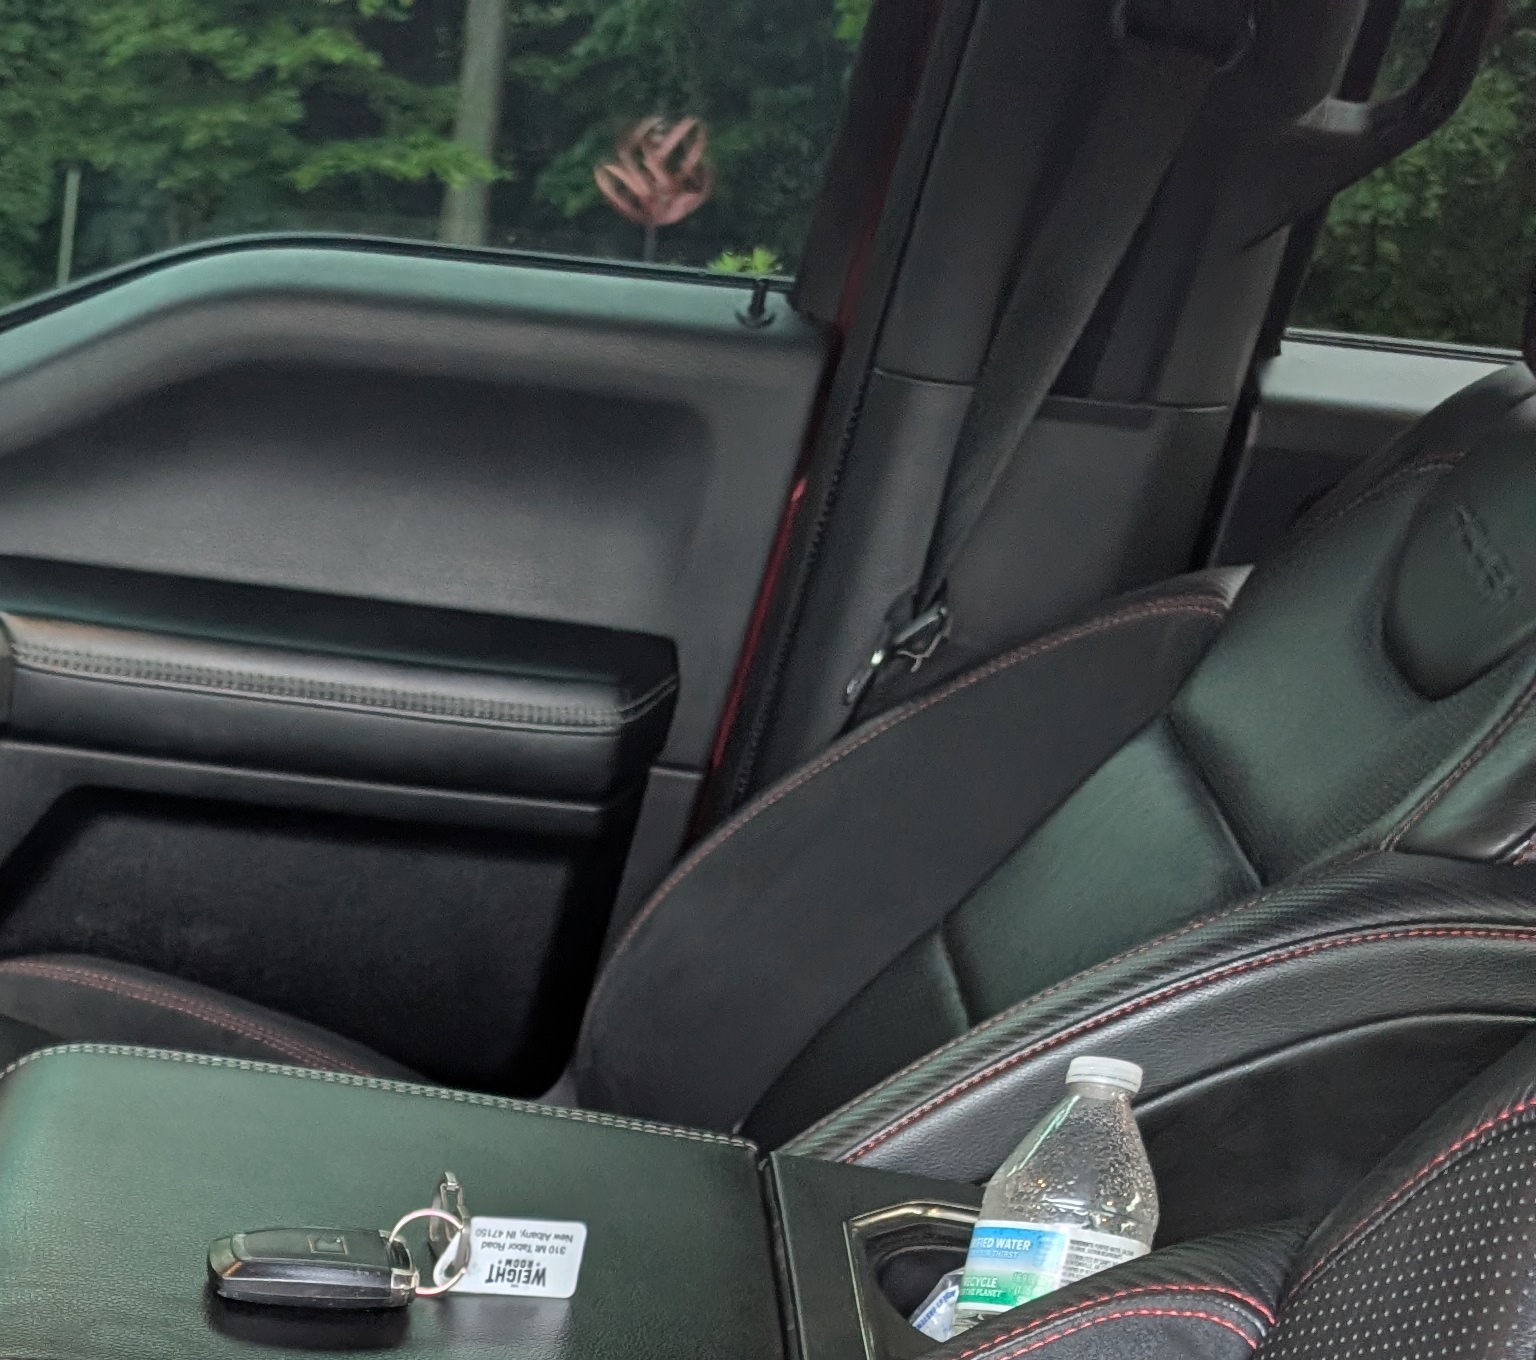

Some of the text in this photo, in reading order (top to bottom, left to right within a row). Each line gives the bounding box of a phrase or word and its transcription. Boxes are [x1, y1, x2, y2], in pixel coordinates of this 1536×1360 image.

[476, 1229, 573, 1243] New Albany, IN 47150
[481, 1241, 566, 1255] 310 Mt Tabor Road
[995, 1238, 1032, 1251] WATER
[992, 1250, 1019, 1260] THIRST
[505, 1259, 534, 1268] ROOM
[485, 1263, 547, 1287] WEIGHT
[975, 1289, 1003, 1298] PLANET
